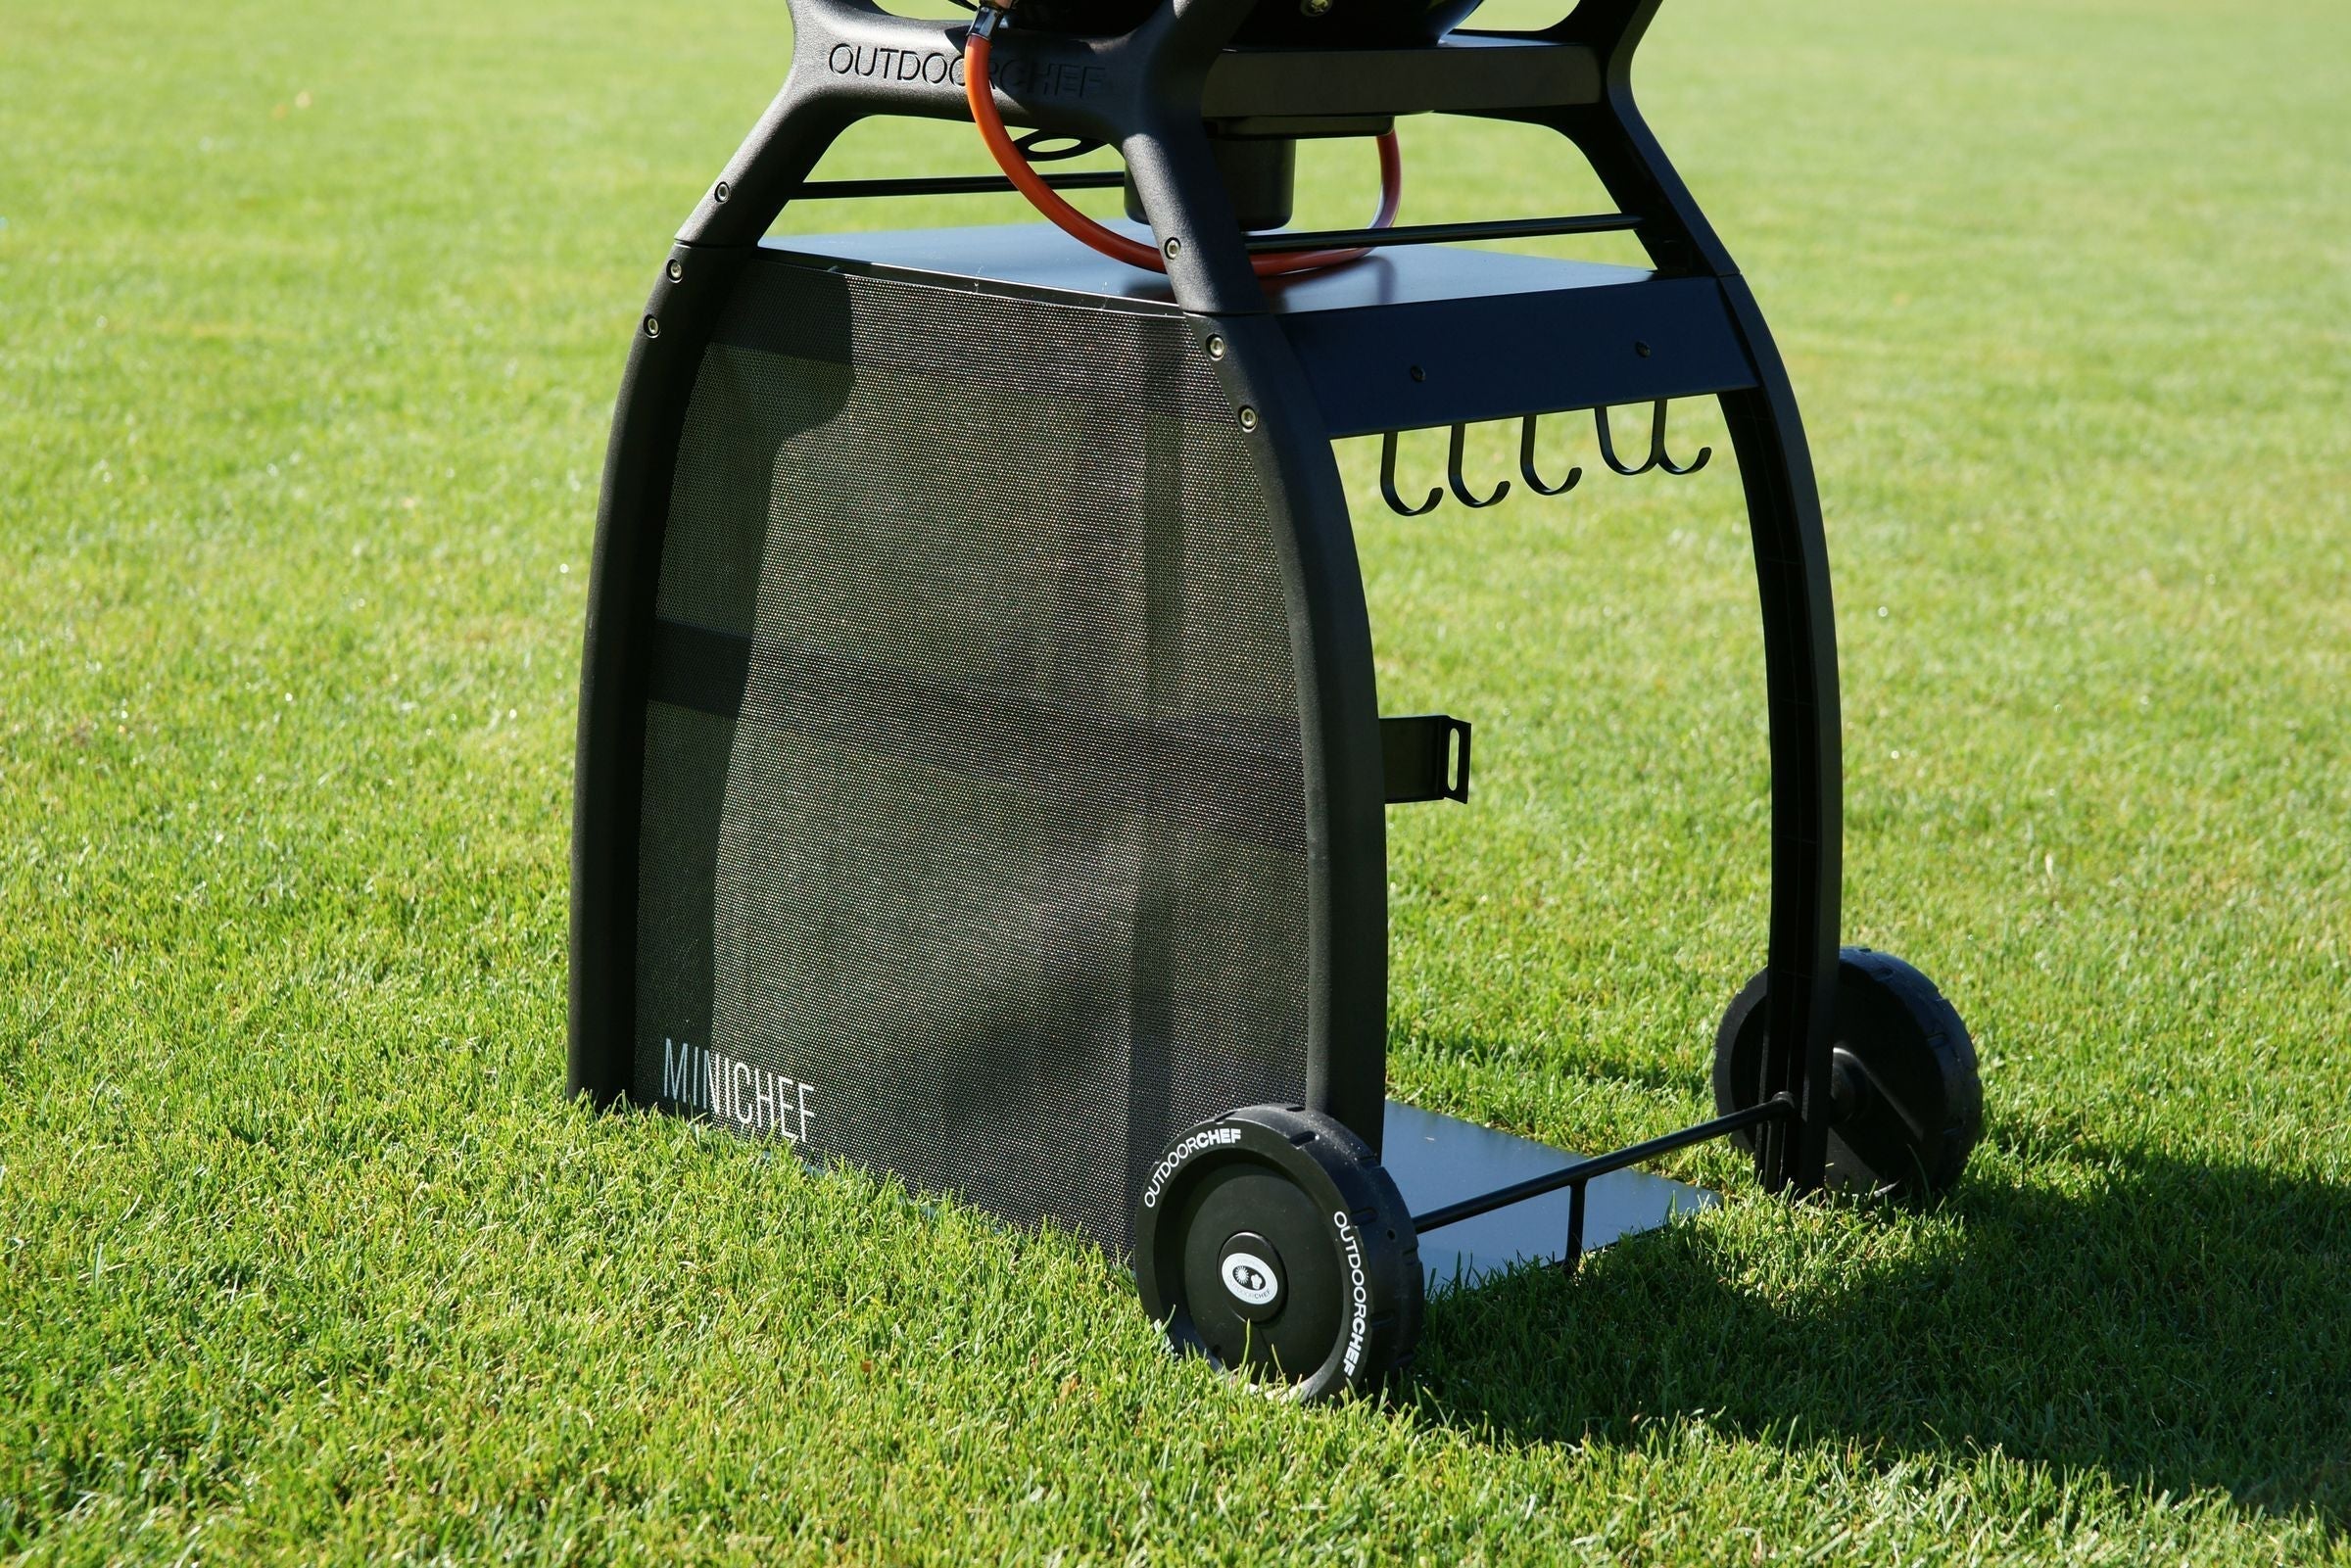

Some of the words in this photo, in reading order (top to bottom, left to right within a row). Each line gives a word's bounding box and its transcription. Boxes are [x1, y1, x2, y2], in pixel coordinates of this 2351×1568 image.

[664, 1037, 815, 1143] MINICHEF
[1144, 1128, 1241, 1208] OUTDOORCHEF
[1333, 1211, 1367, 1377] OUTDOORCHEF
